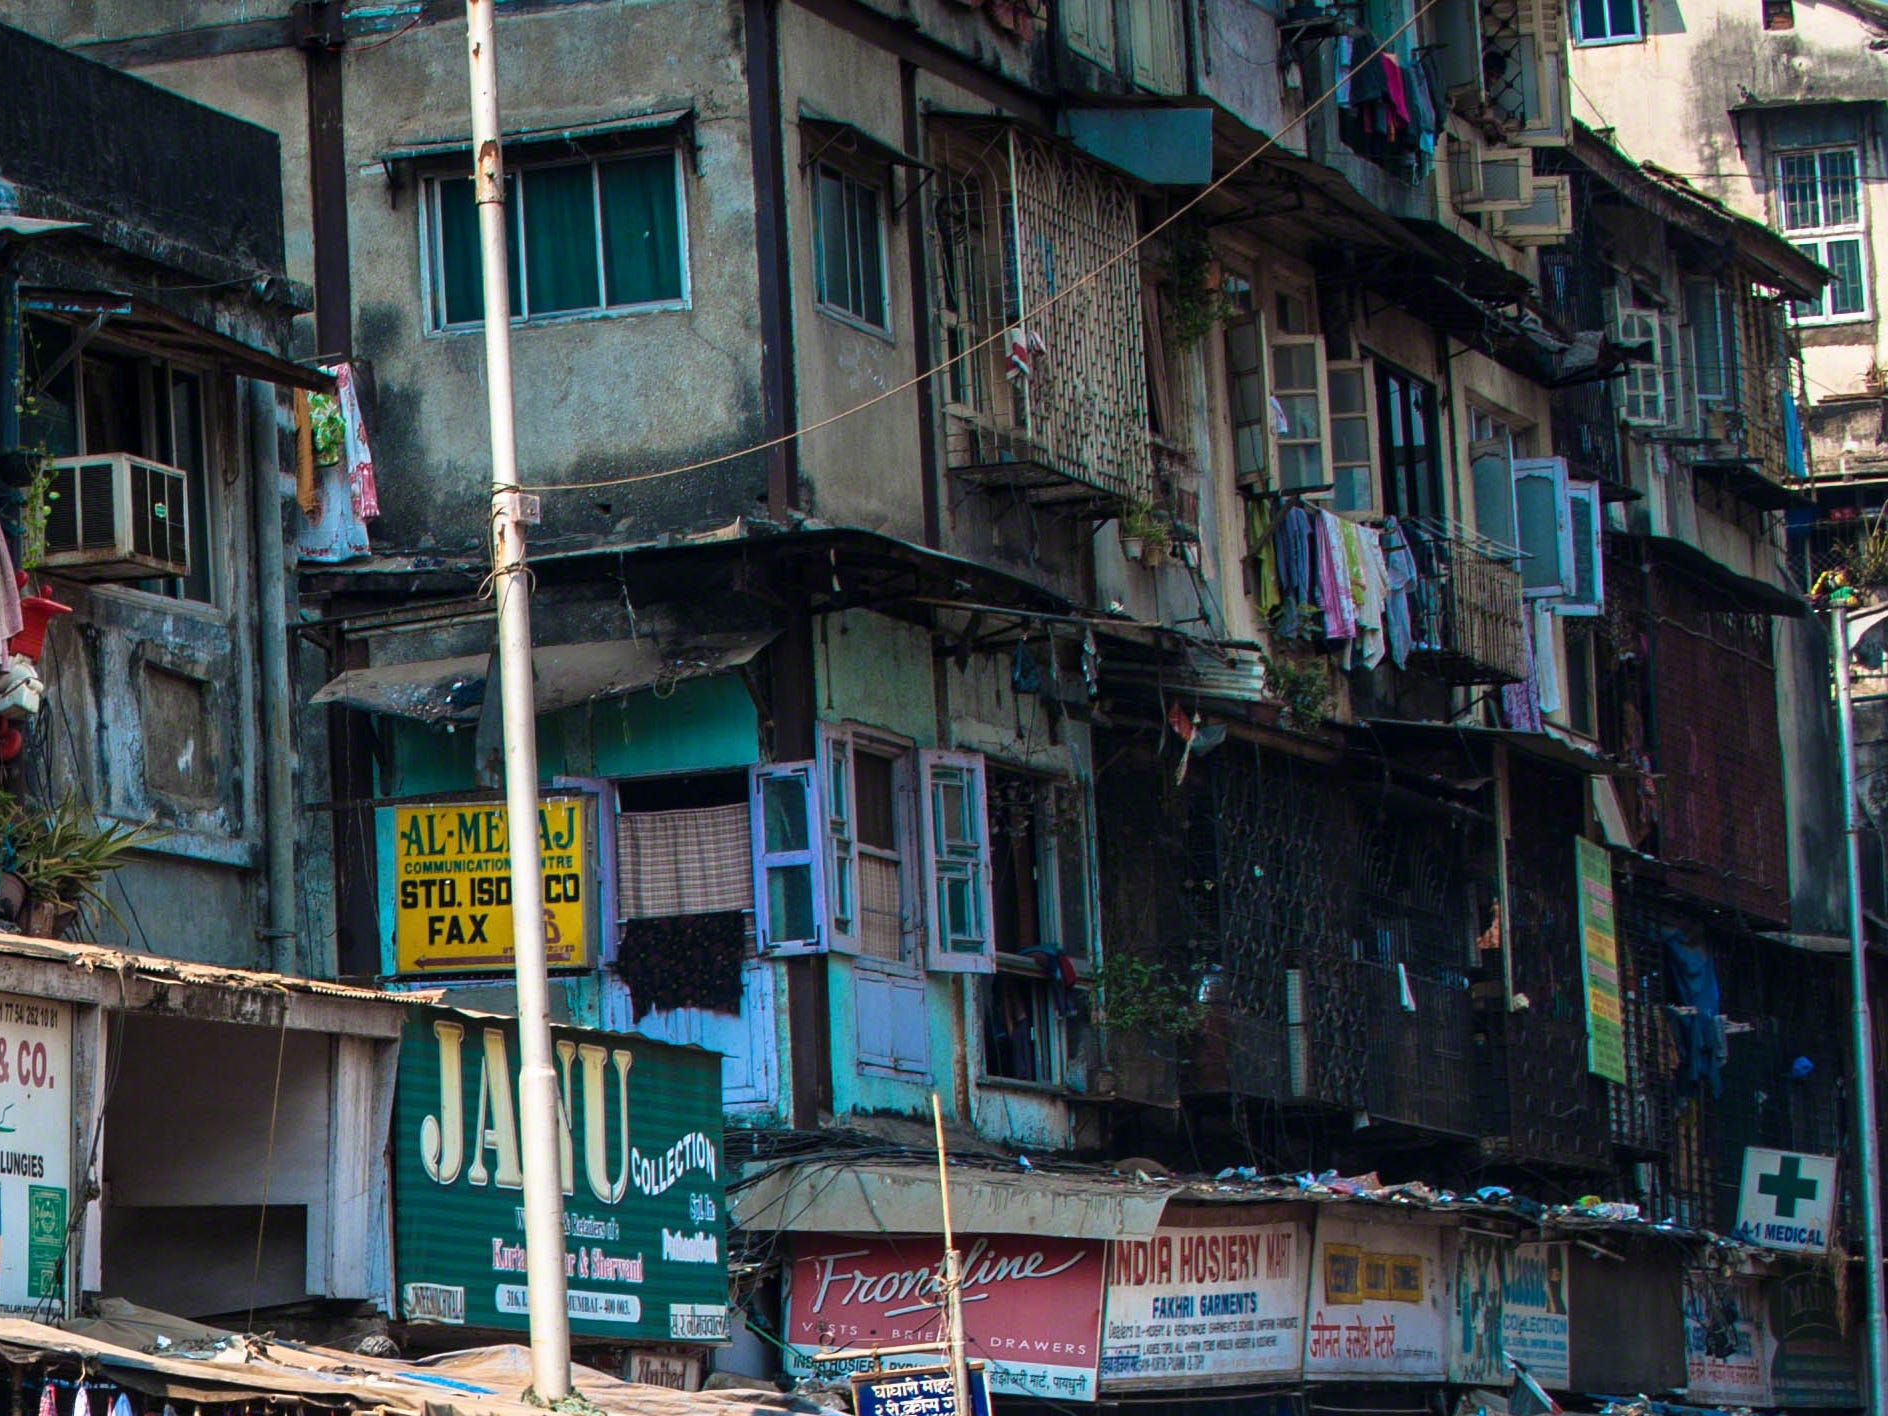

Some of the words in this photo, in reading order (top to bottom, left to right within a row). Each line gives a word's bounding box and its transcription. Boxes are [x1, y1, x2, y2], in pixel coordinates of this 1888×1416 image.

[544, 873, 580, 904] CO
[428, 913, 489, 946] FAX
[17, 1039, 54, 1090] CO.
[0, 1149, 45, 1179] LUNGIES
[631, 1131, 716, 1195] COLLECTION
[1764, 1223, 1825, 1247] MEDICAL
[577, 1246, 590, 1279] &
[591, 1247, 645, 1284] Sherwani
[1178, 1233, 1261, 1284] HOSIERY
[1266, 1232, 1292, 1280] MART
[1153, 1296, 1195, 1319] FAKHRI
[1200, 1292, 1258, 1317] GARMENTS
[990, 1336, 1087, 1356] DRAWERS
